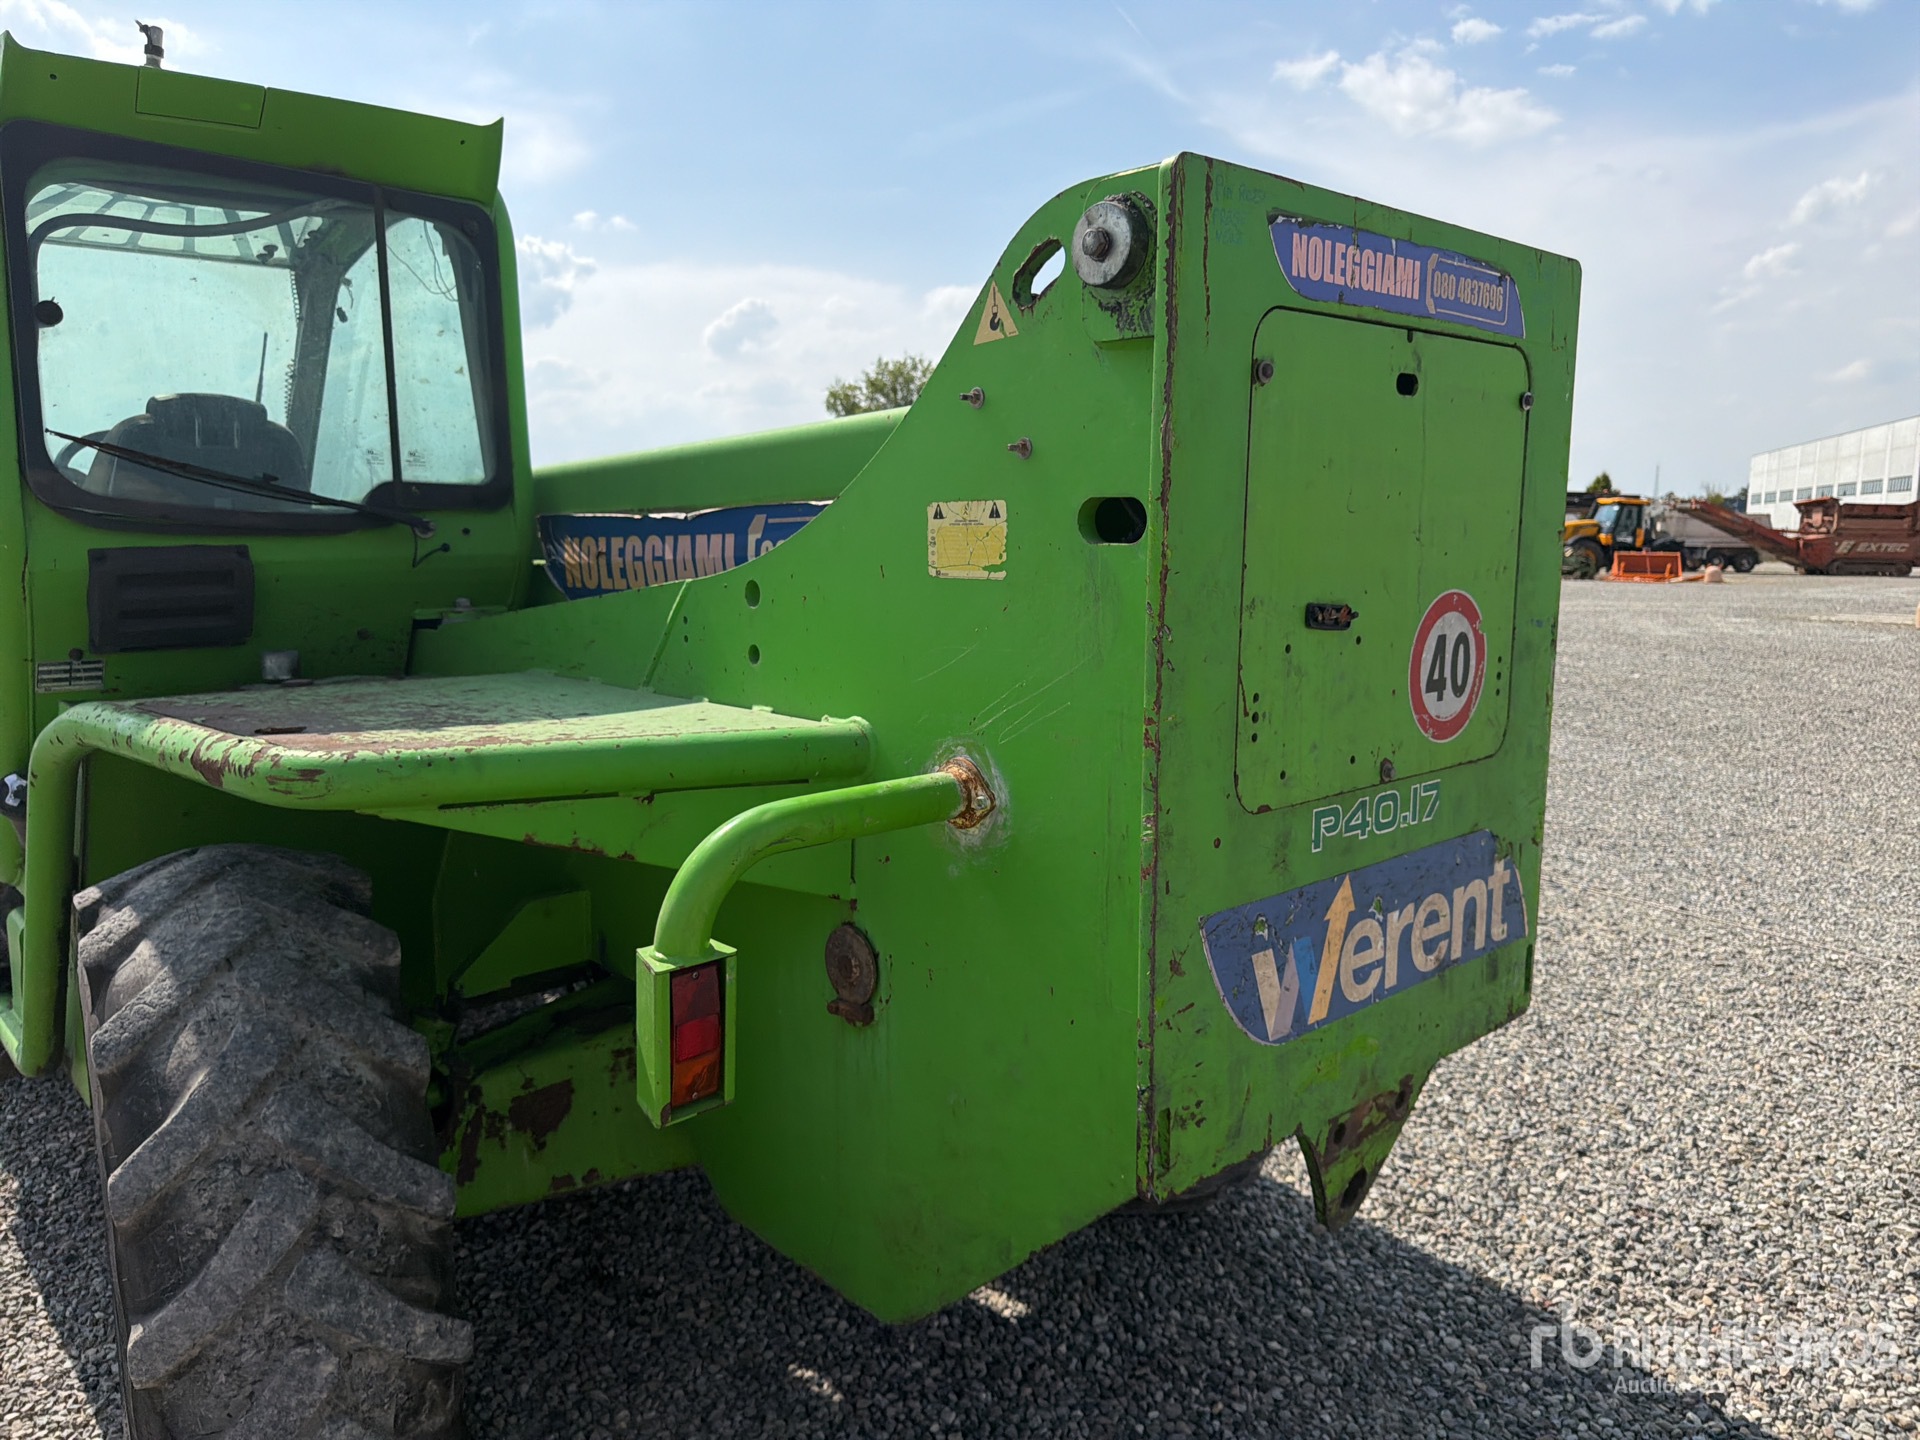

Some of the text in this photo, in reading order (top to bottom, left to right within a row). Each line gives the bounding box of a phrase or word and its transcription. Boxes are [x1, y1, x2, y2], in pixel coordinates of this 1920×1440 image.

[1291, 232, 1421, 300] NOLEGGIAMI
[1433, 271, 1504, 312] 080 4837696
[564, 533, 736, 590] NOLEGGIAMI
[1856, 542, 1910, 553] EXTEC
[1425, 631, 1471, 702] 40
[1311, 779, 1442, 854] P40.17
